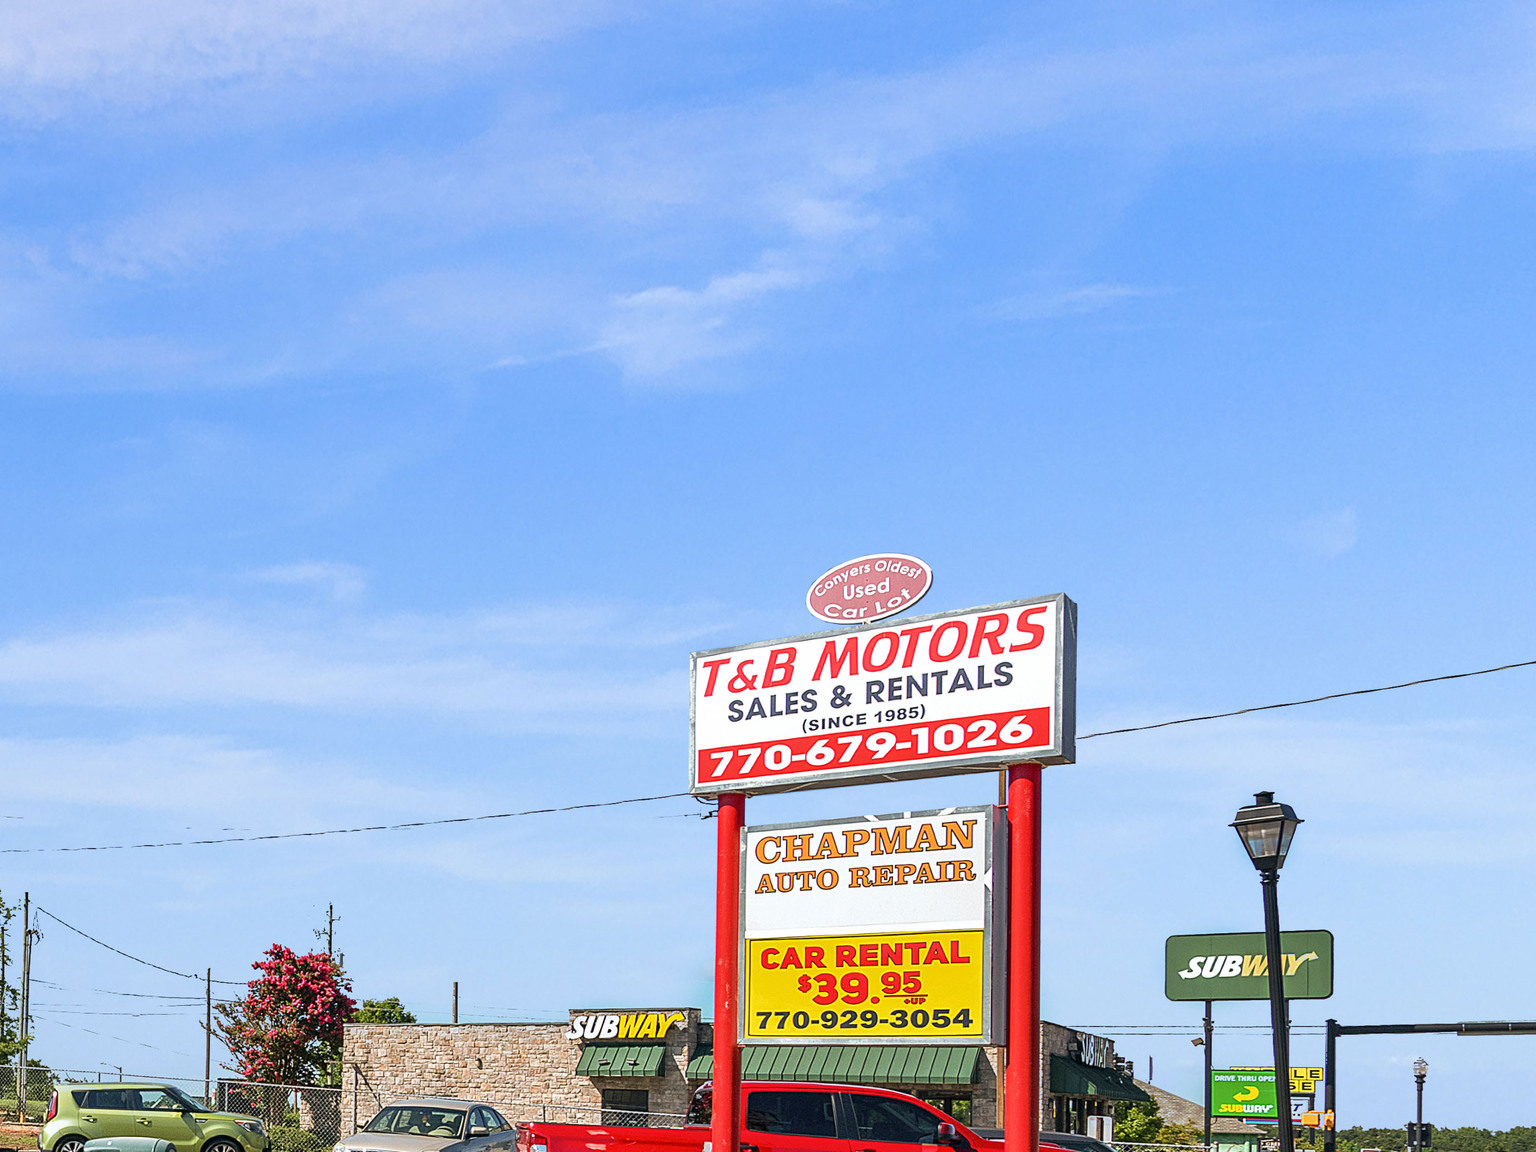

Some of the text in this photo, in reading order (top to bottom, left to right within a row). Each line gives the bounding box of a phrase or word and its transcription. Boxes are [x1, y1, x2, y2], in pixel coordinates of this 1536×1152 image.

[814, 560, 922, 597] Conyers Oldest
[843, 577, 890, 600] Used
[824, 588, 912, 618] Car Lot
[702, 605, 1048, 698] T&B MOTORS
[728, 661, 1014, 723] SALES & RENTALS
[802, 703, 926, 734] (SINCE 1985)
[710, 715, 1033, 777] 770-679-1026
[755, 820, 977, 864] CHAPMAN
[755, 860, 976, 894] AUTO REPAIR
[761, 941, 970, 970] CAR RENTAL
[565, 1012, 685, 1040] SUBWAY
[756, 1008, 973, 1030] 770-929-3054
[1218, 1104, 1274, 1113] SUBWAY
